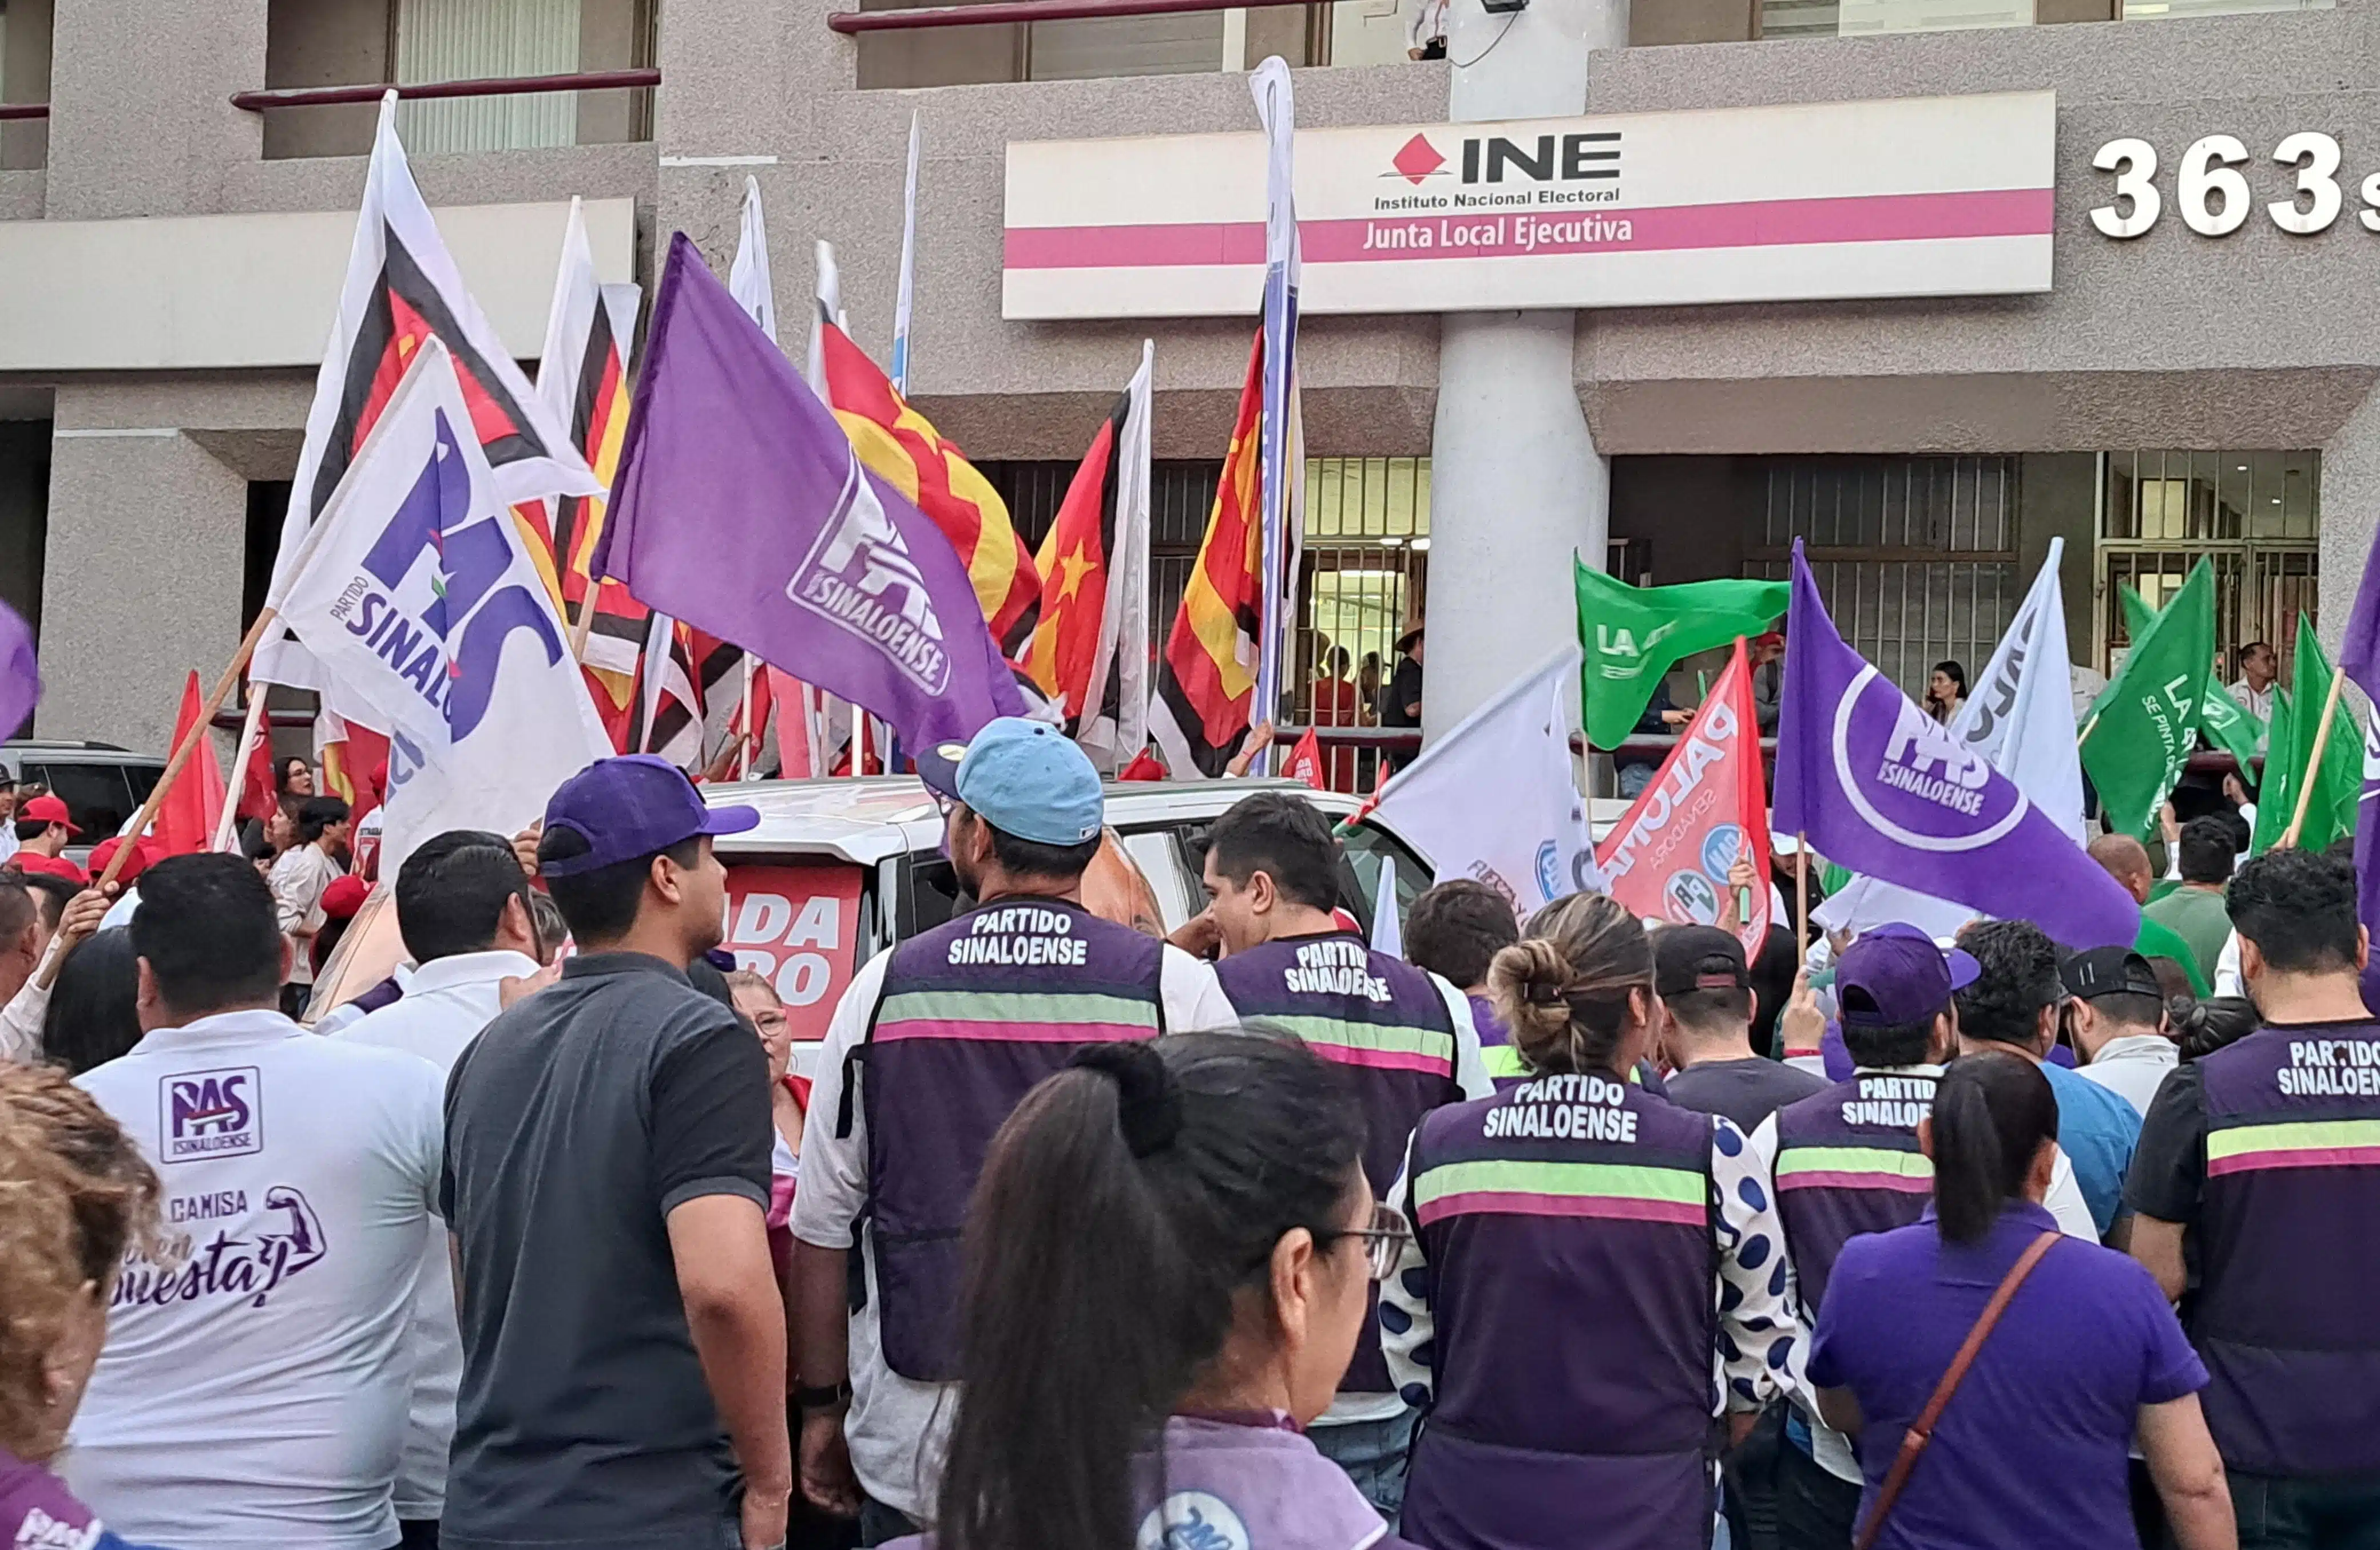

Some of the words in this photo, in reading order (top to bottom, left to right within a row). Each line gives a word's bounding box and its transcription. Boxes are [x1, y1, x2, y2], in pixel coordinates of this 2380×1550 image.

[1462, 132, 1622, 184] INE
[1374, 196, 1448, 210] Instituto
[1454, 191, 1532, 207] Nacional
[1538, 188, 1620, 204] Electoral
[1363, 221, 1433, 250] Junta
[1440, 217, 1504, 247] Local
[1514, 214, 1632, 252] Ejecutiva
[330, 576, 369, 621] PARTIDO
[812, 576, 945, 683] SINALOENSE
[2164, 673, 2192, 724] LA
[2151, 712, 2176, 756] PINTA
[1881, 763, 1985, 818] SINALOENSE
[971, 907, 1072, 934] PARTIDO
[947, 936, 1088, 965] SINALOENSE
[173, 1075, 250, 1138] PAS
[1514, 1073, 1624, 1107] PARTIDO
[1483, 1104, 1637, 1143] SINALOENSE
[170, 1190, 248, 1223] CAMISA
